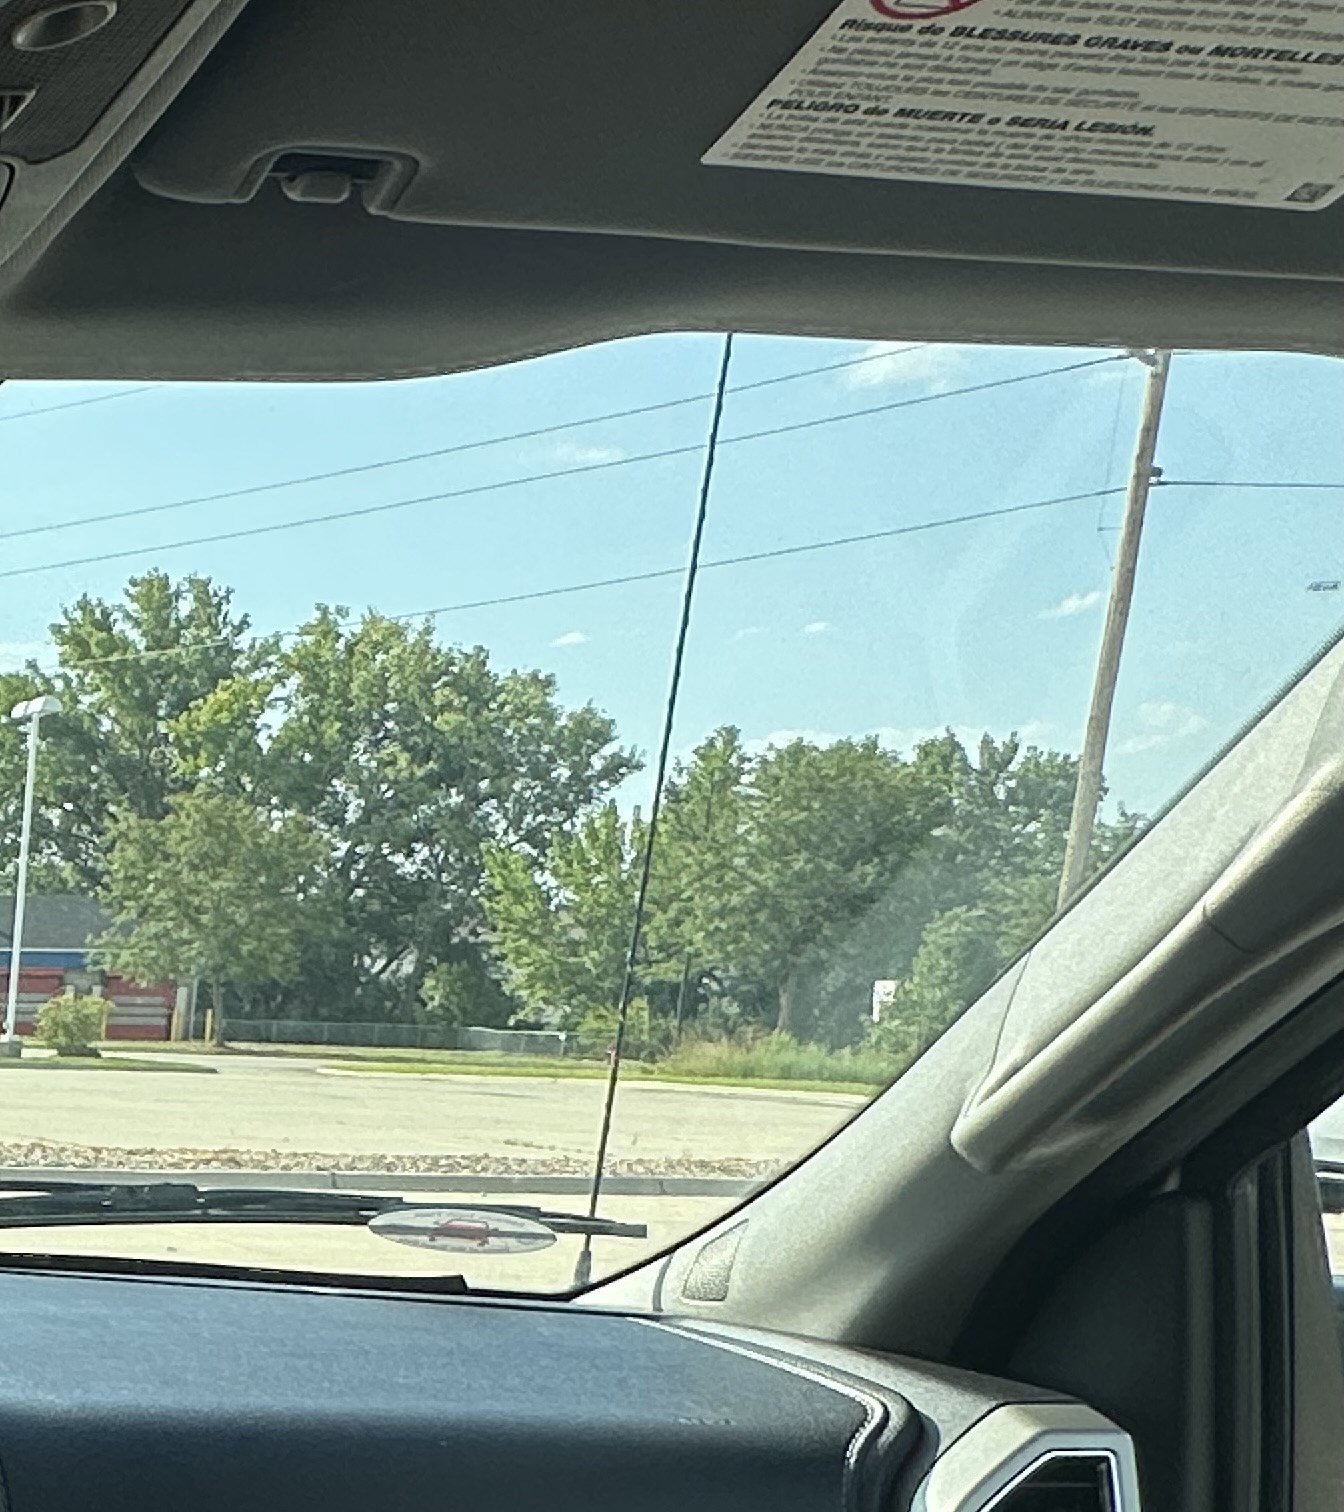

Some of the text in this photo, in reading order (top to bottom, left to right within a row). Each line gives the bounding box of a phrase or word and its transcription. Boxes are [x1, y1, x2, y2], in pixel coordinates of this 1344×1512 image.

[839, 19, 913, 34] Risque
[917, 23, 945, 35] de
[949, 25, 1081, 46] BLESSURES
[1083, 36, 1173, 53] GRAVES
[766, 98, 860, 113] PELIGRO
[862, 105, 889, 116] de
[893, 108, 985, 124] MUERTE
[1005, 116, 1069, 130] SERIA
